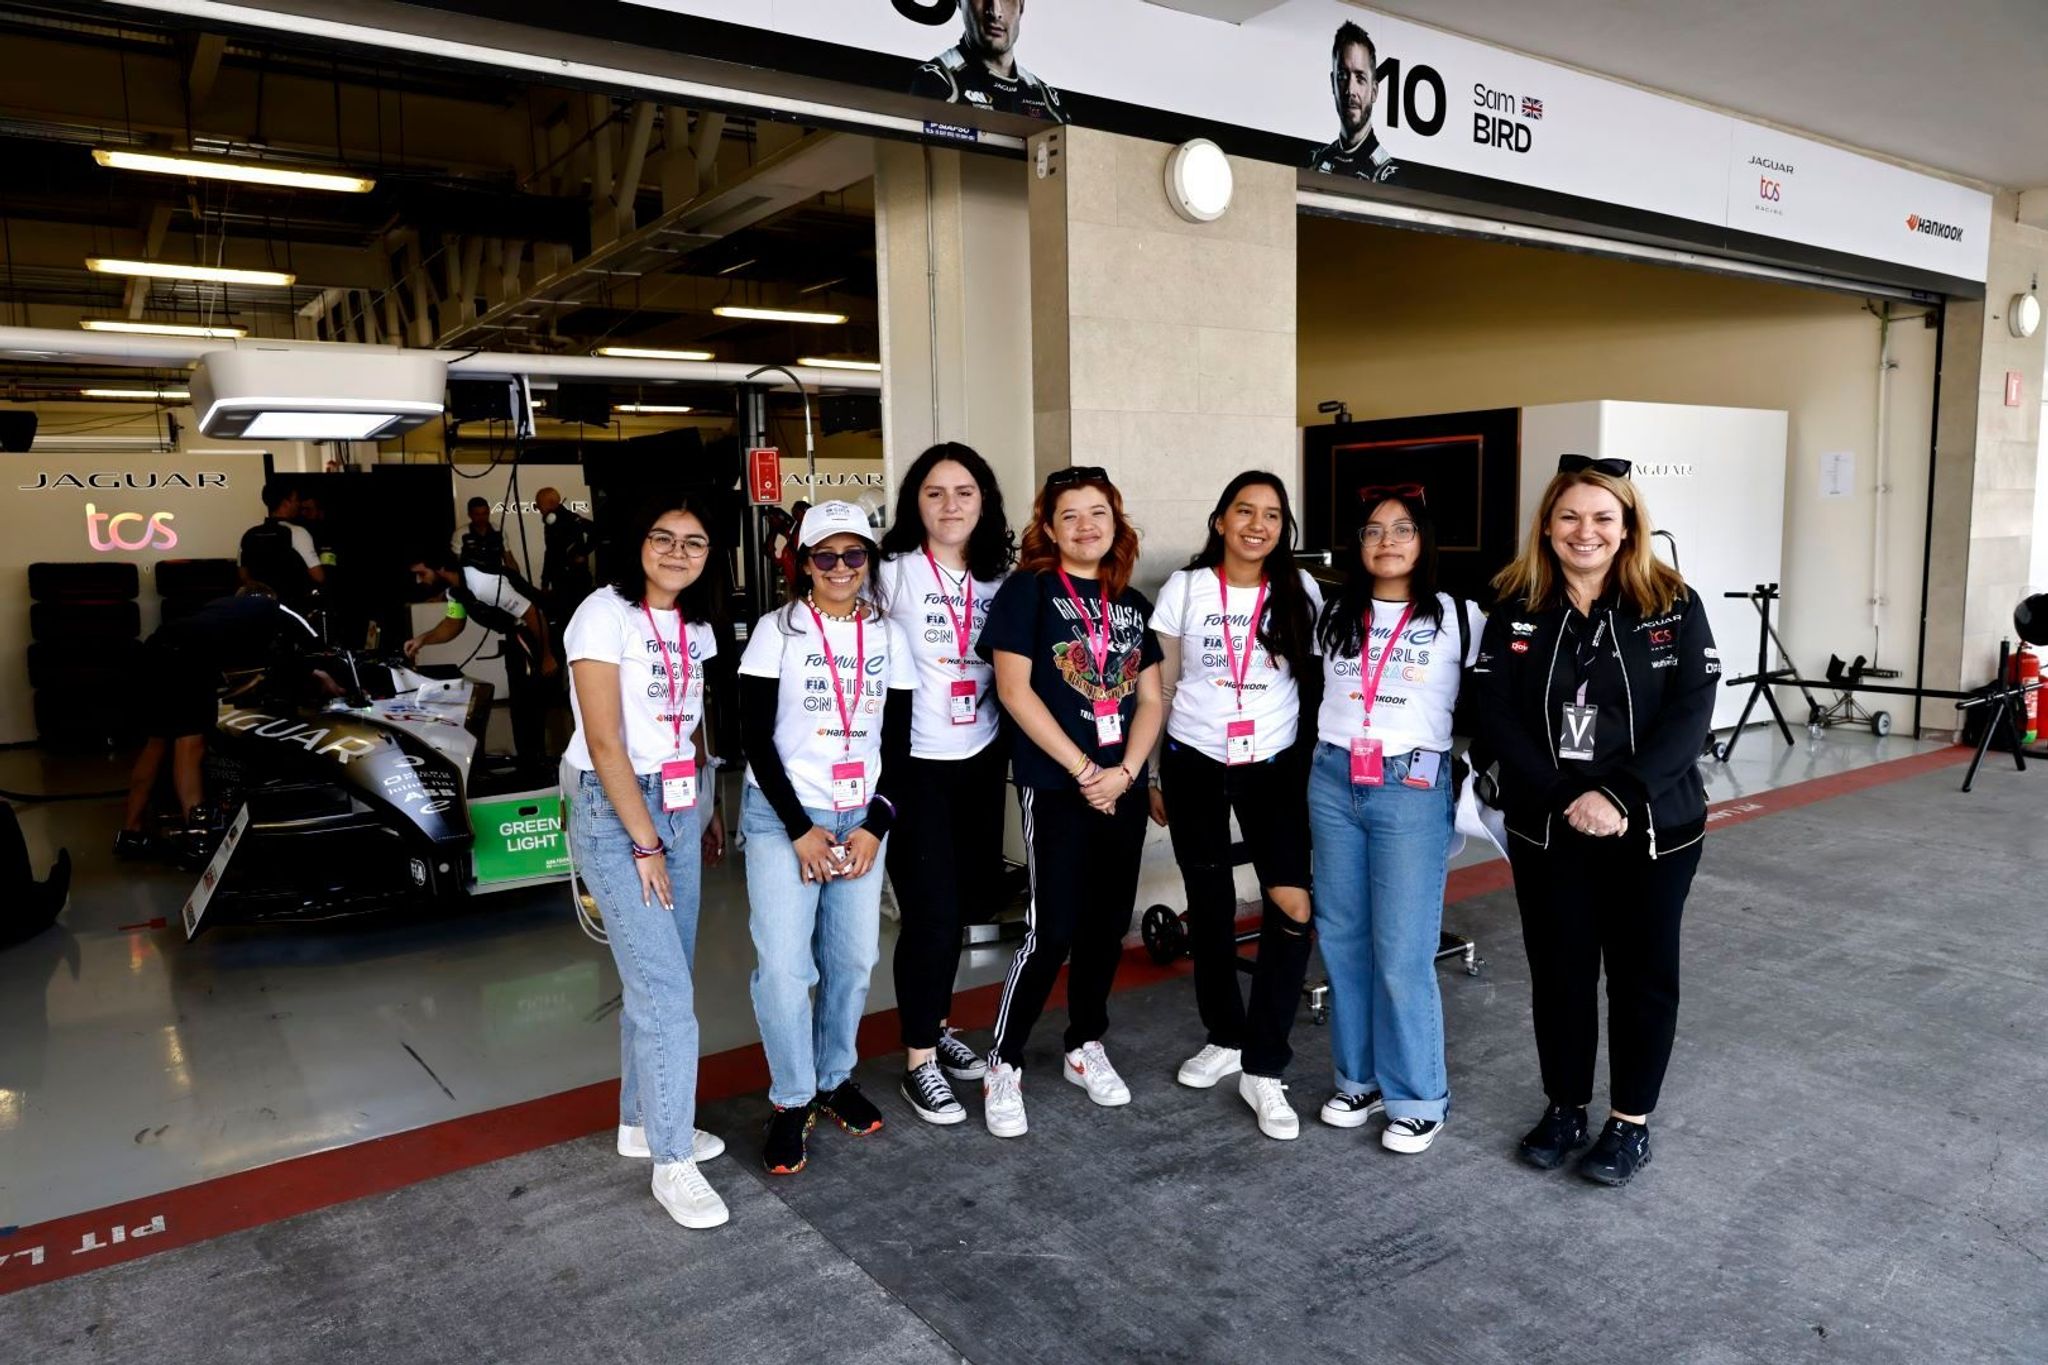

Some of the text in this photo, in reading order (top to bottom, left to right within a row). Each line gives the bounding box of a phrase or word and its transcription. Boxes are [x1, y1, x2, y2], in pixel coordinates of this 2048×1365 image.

[1376, 57, 1447, 137] 10
[1473, 83, 1516, 115] Sam
[1473, 112, 1533, 153] BIRD
[1748, 155, 1794, 175] JAGUAR
[1759, 175, 1780, 202] tcs
[782, 472, 885, 487] AGUAR
[1634, 463, 1695, 476] AGUAR
[18, 472, 230, 491] JAGUAR
[85, 502, 178, 551] tcs
[1633, 614, 1682, 632] JAGUAR
[1368, 646, 1430, 666] GRLS
[803, 696, 832, 712] ON
[217, 709, 376, 764] GUAR
[499, 817, 562, 836] GREEN
[507, 833, 559, 853] LIGHT
[71, 1215, 166, 1256] PIT
